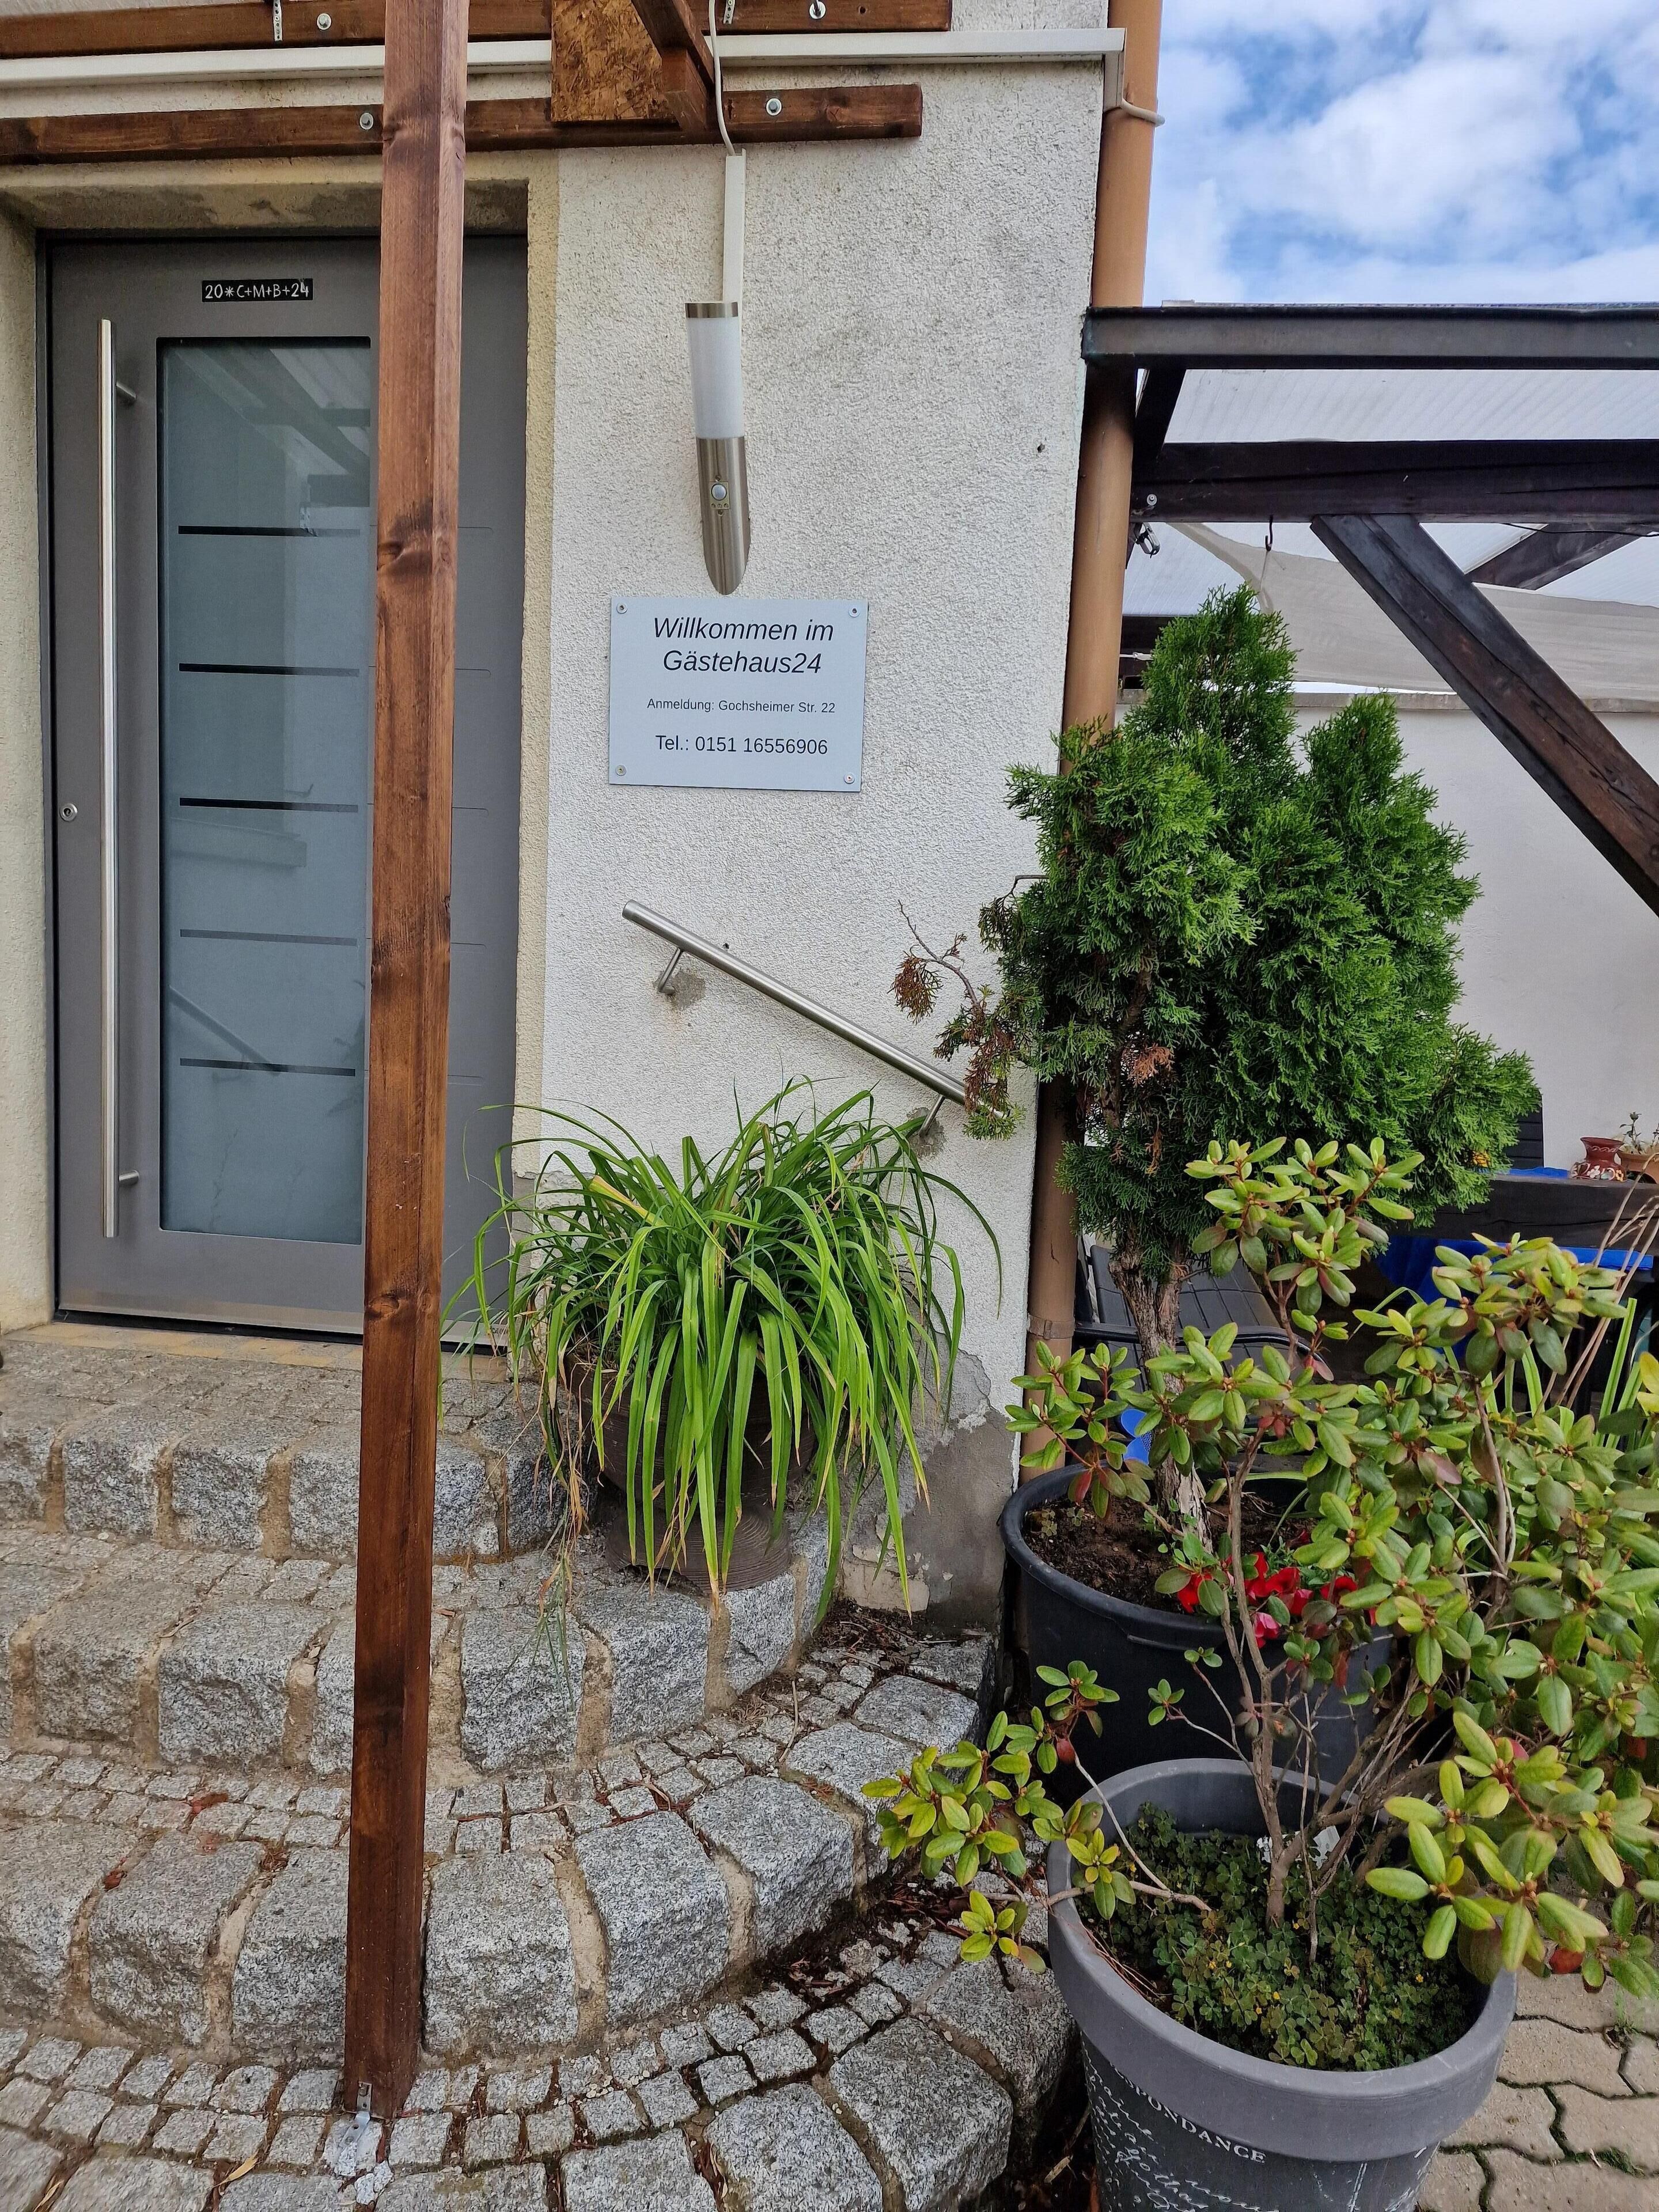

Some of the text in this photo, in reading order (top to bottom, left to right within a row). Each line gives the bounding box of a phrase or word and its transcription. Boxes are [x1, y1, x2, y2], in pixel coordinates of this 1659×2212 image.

[654, 617, 834, 641] Willkommen im
[664, 650, 821, 673] Gästehaus24
[647, 698, 835, 713] Anmeldung: Gochsheimer Str. 22
[655, 735, 828, 755] Tel.: 0151 16556906
